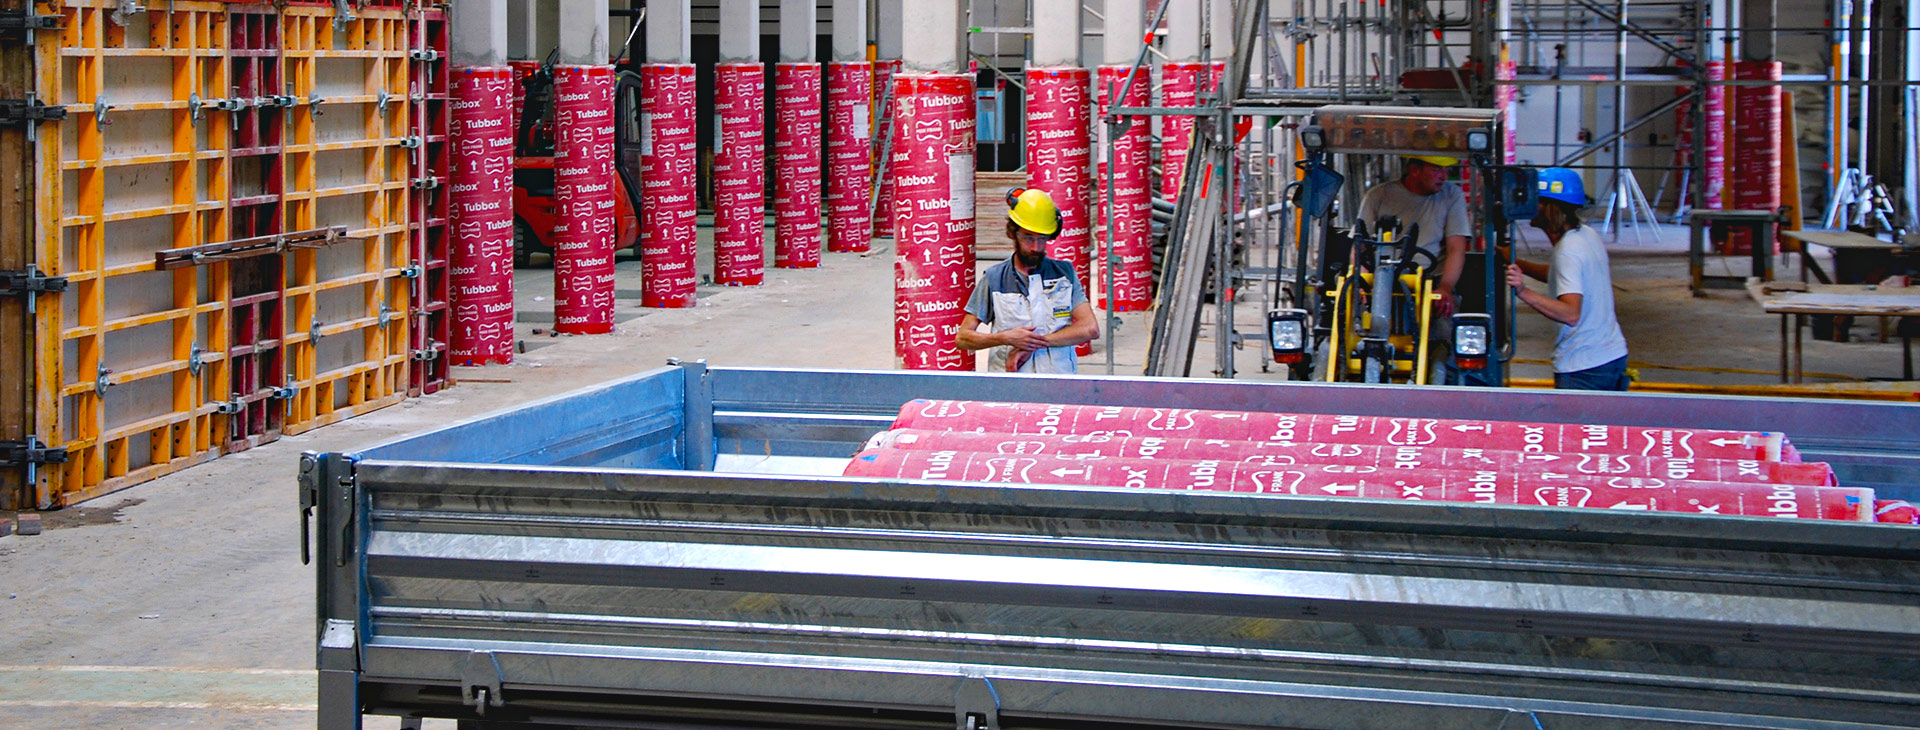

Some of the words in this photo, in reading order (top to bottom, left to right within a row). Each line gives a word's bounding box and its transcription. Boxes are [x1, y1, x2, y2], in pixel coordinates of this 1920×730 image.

[560, 93, 590, 102] Tubbox
[920, 95, 964, 108] Tubbox
[576, 110, 608, 118] Tubbox
[466, 118, 502, 128] Tubbox
[948, 118, 976, 130] Tubbo
[597, 126, 615, 136] Tubb
[661, 128, 690, 136] Tubbox
[1040, 130, 1075, 139] Tubbox
[488, 136, 513, 148] Tubbo
[1061, 147, 1089, 157] Tubbo
[559, 168, 590, 176] Tubbox
[722, 178, 748, 186] Tubbox
[897, 175, 936, 186] Tubbox
[576, 184, 608, 193] Tubbox
[1114, 187, 1144, 196] Tubbox
[659, 195, 688, 204] Tubbox
[917, 198, 952, 210] Tubb
[464, 202, 500, 212] Tubbox
[596, 200, 615, 210] Tubb
[486, 220, 513, 230] Tubbo
[945, 220, 976, 233] Tubbo
[559, 242, 588, 250] Tubbox
[576, 258, 607, 268] Tubbox
[657, 262, 686, 271] Tubbox
[596, 274, 615, 284] Tubb
[896, 278, 932, 288] Tubbox
[461, 284, 498, 295] Tubbox
[914, 300, 959, 313] Tubbox
[1270, 415, 1298, 440] box
[921, 450, 958, 480] Tubb
[1271, 470, 1285, 492] FRANK
[1557, 487, 1569, 507] RANK
